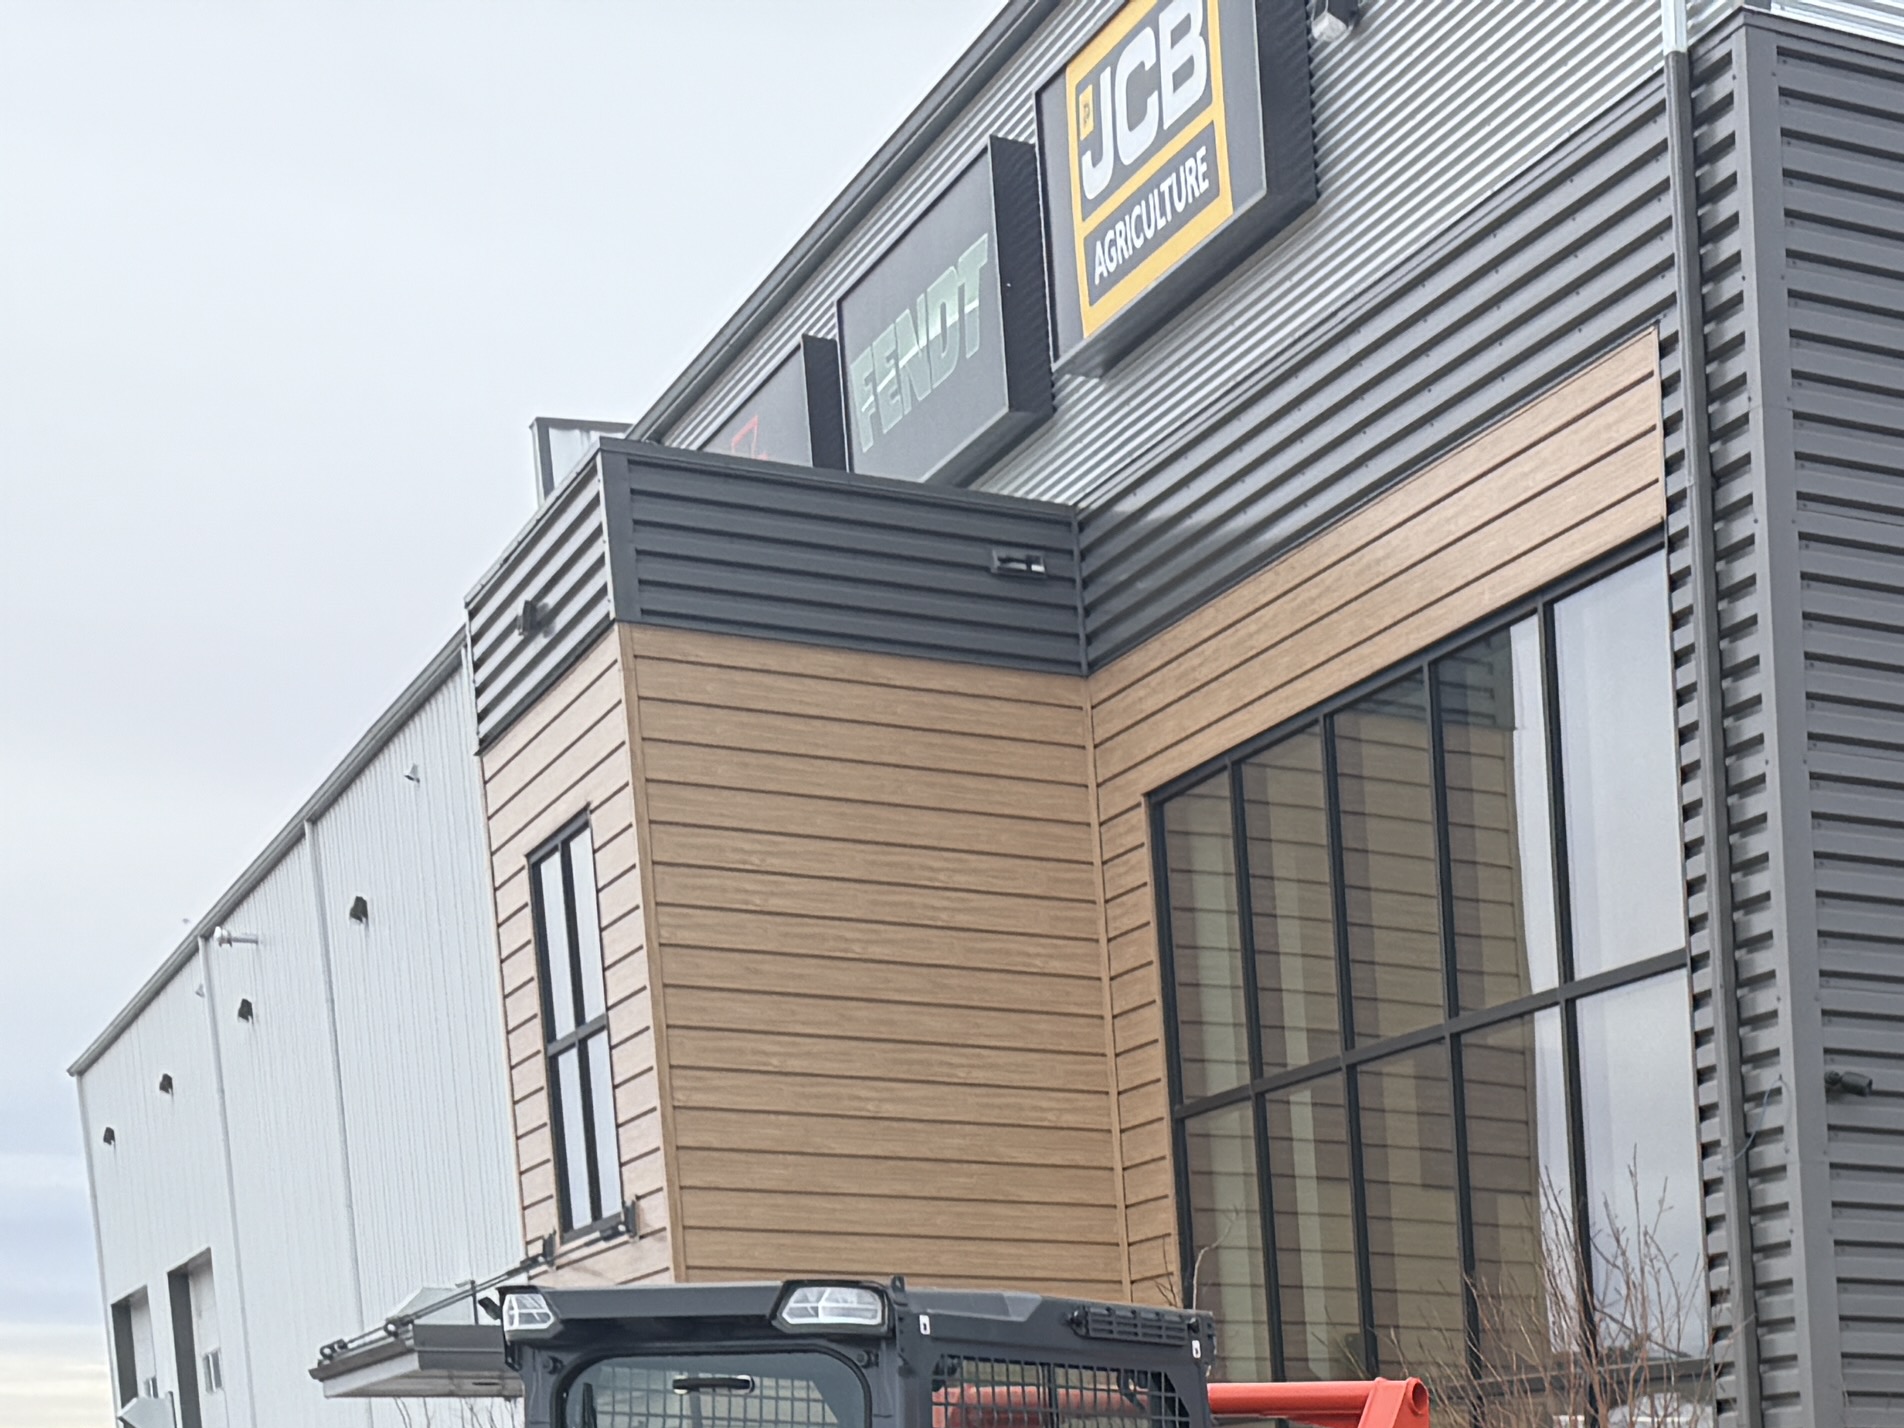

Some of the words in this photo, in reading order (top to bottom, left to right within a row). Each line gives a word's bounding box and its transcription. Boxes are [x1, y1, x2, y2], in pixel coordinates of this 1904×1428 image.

[1081, 0, 1209, 201] JCB
[1093, 146, 1210, 286] AGRICULTURE
[850, 232, 990, 455] FENDT
